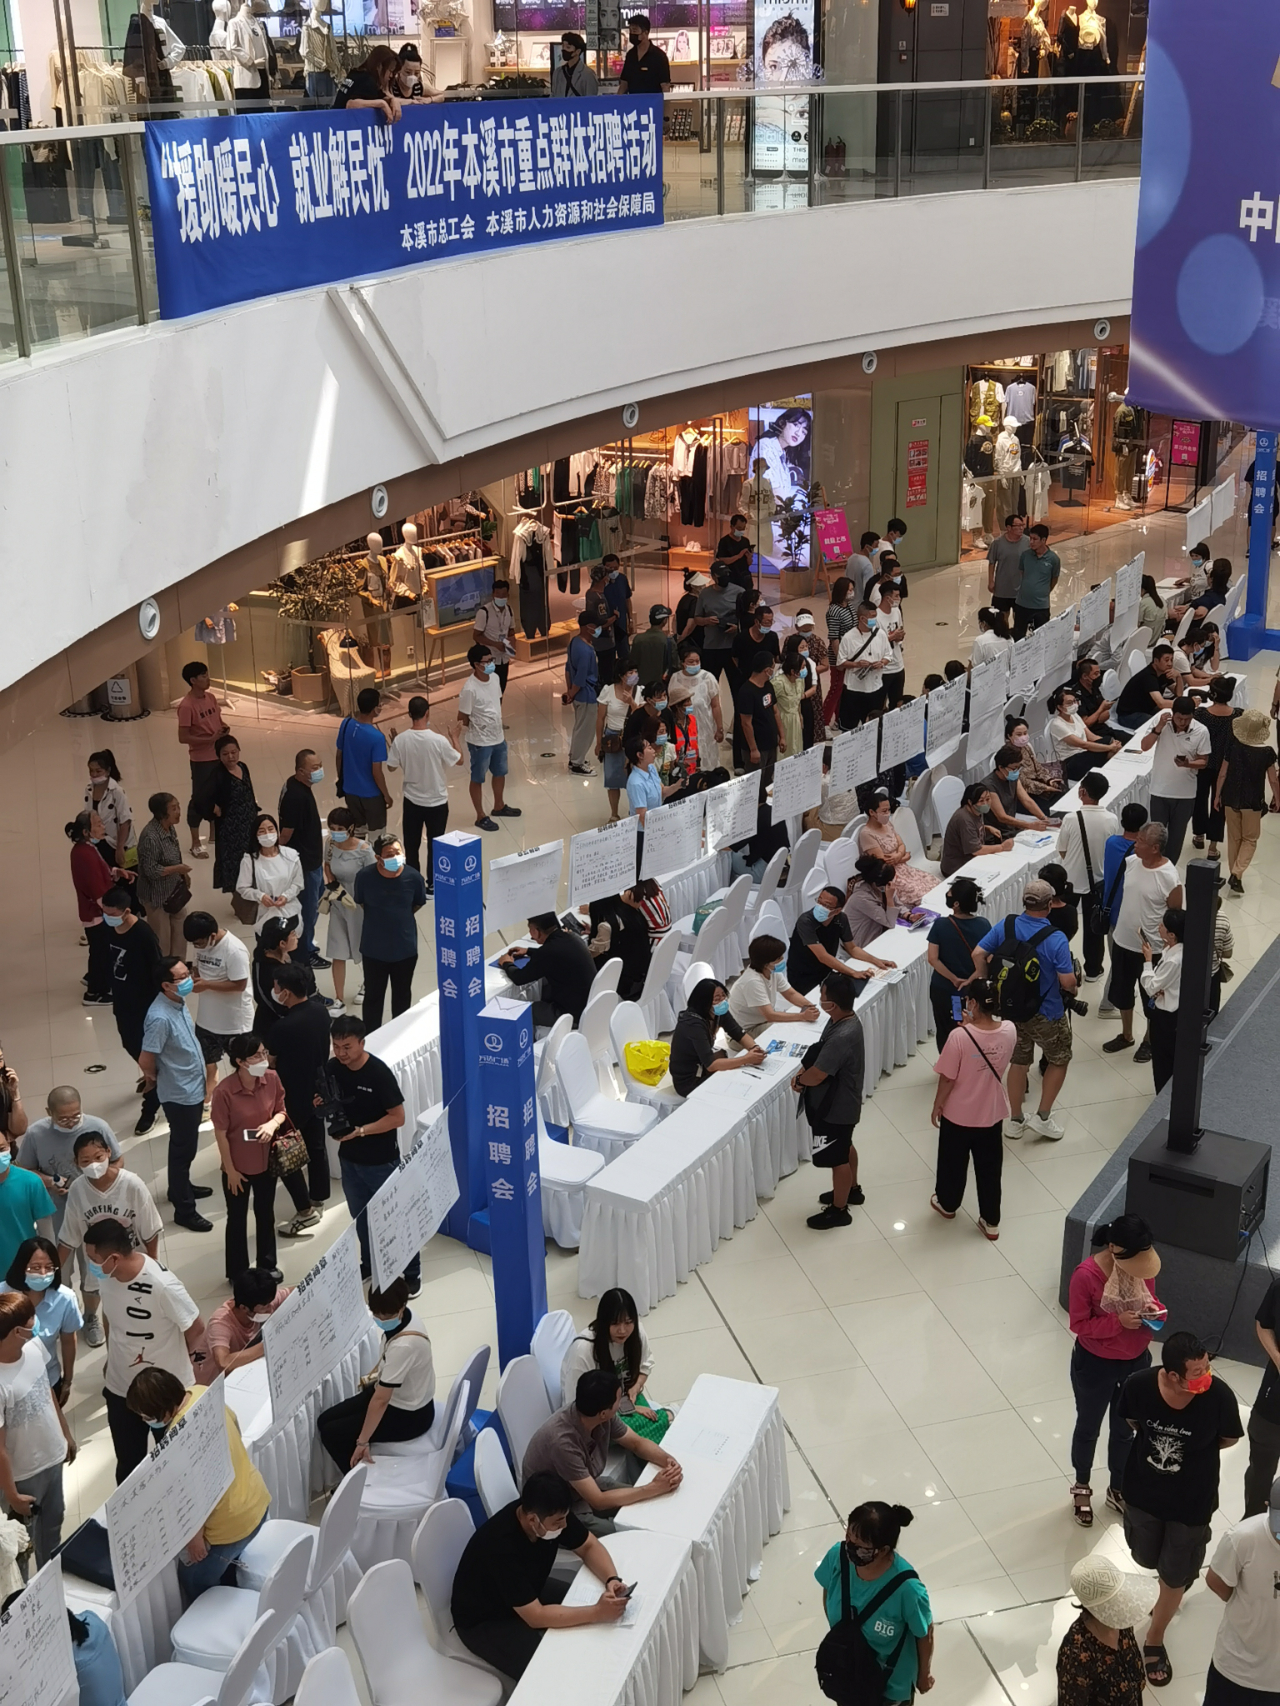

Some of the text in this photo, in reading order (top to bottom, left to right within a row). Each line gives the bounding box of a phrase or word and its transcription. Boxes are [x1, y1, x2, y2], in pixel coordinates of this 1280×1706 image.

[161, 107, 657, 244] “援助暖民心 就业解民忧” 2022年本溪市重点群体招聘活动
[400, 191, 656, 251] 本溪市总工会 本溪市人力资源和社会保障局
[1239, 191, 1280, 243] 中
[1254, 470, 1267, 514] 招聘会
[439, 915, 458, 999] 招聘会
[465, 914, 482, 998] 招聘会
[487, 1104, 514, 1200] 招聘会
[523, 1097, 537, 1197] 招聘会
[84, 1204, 119, 1220] SURFING
[1164, 1424, 1178, 1433] idea
[874, 1620, 895, 1637] BIG
